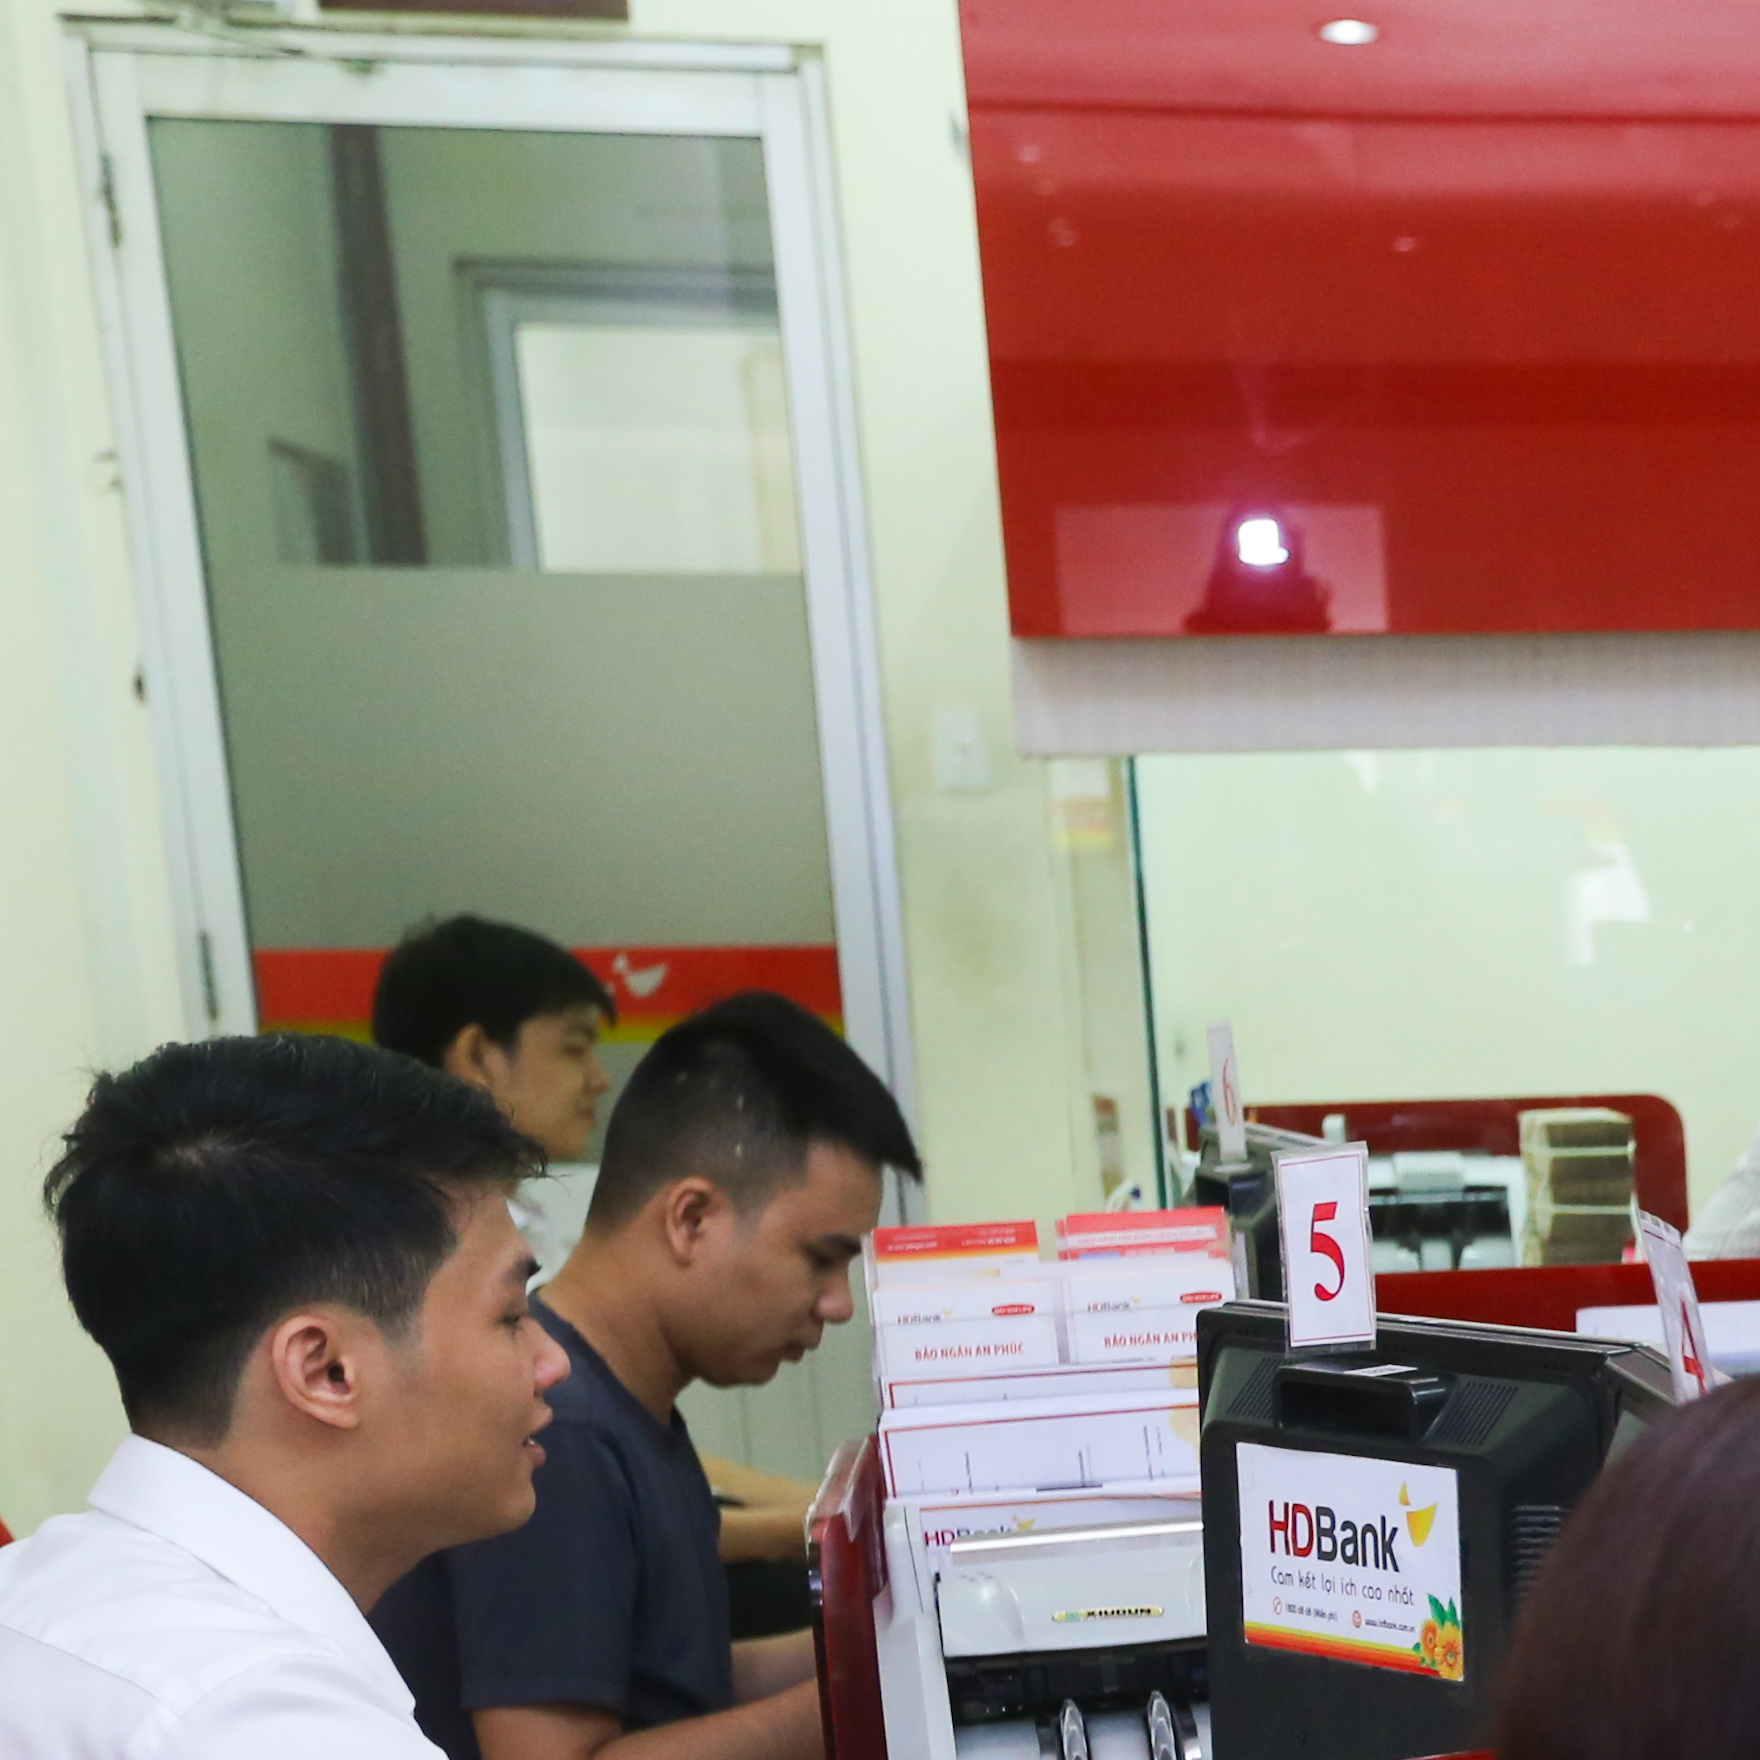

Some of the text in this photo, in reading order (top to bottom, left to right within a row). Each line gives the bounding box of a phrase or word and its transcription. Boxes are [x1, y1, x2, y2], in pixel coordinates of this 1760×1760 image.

[1311, 1201, 1345, 1301] 5
[1269, 1500, 1400, 1572] HDBank
[1271, 1566, 1293, 1586] Cam
[1299, 1570, 1315, 1589] kết
[1321, 1573, 1335, 1594] lợi
[1362, 1583, 1382, 1600] cao
[1388, 1587, 1414, 1606] nhất
